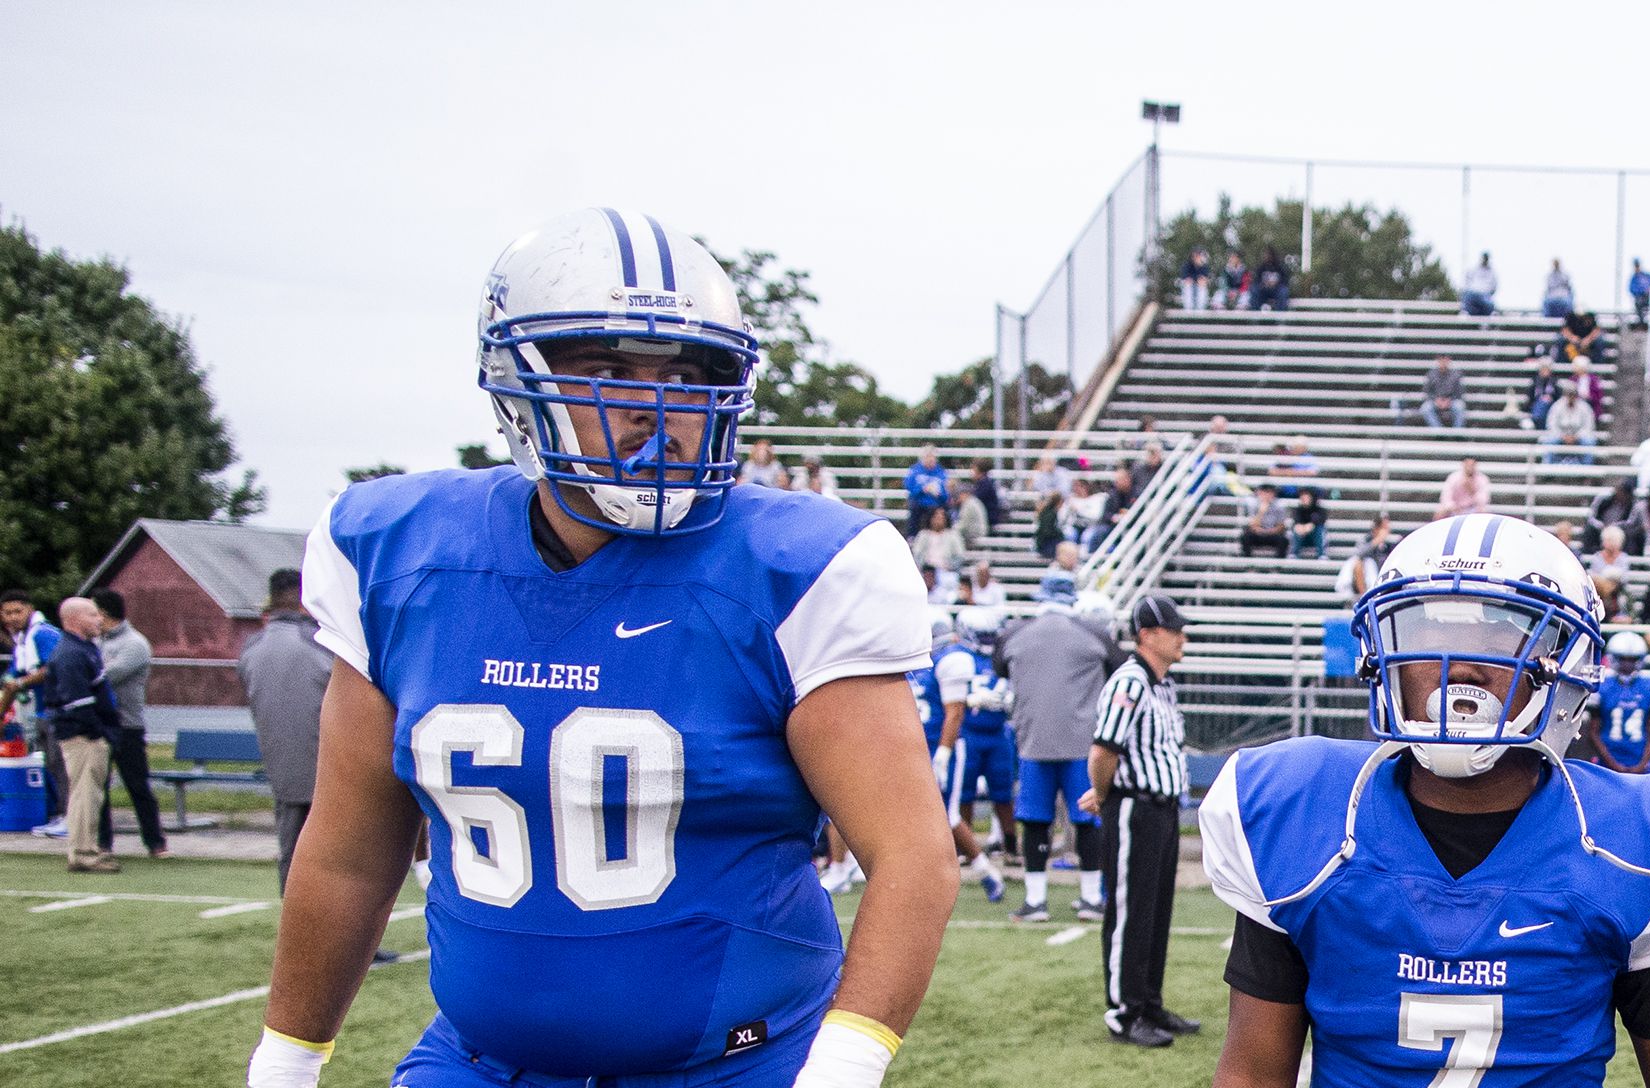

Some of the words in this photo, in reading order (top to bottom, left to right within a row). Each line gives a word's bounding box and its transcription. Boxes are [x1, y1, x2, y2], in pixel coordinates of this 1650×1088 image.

[628, 294, 677, 308] STEEL-HIGH
[1439, 557, 1486, 570] schutt
[481, 658, 600, 692] ROLLERS
[1609, 706, 1645, 742] 14
[411, 703, 685, 912] 60
[1397, 953, 1507, 987] ROLLERS
[736, 1029, 758, 1045] XL
